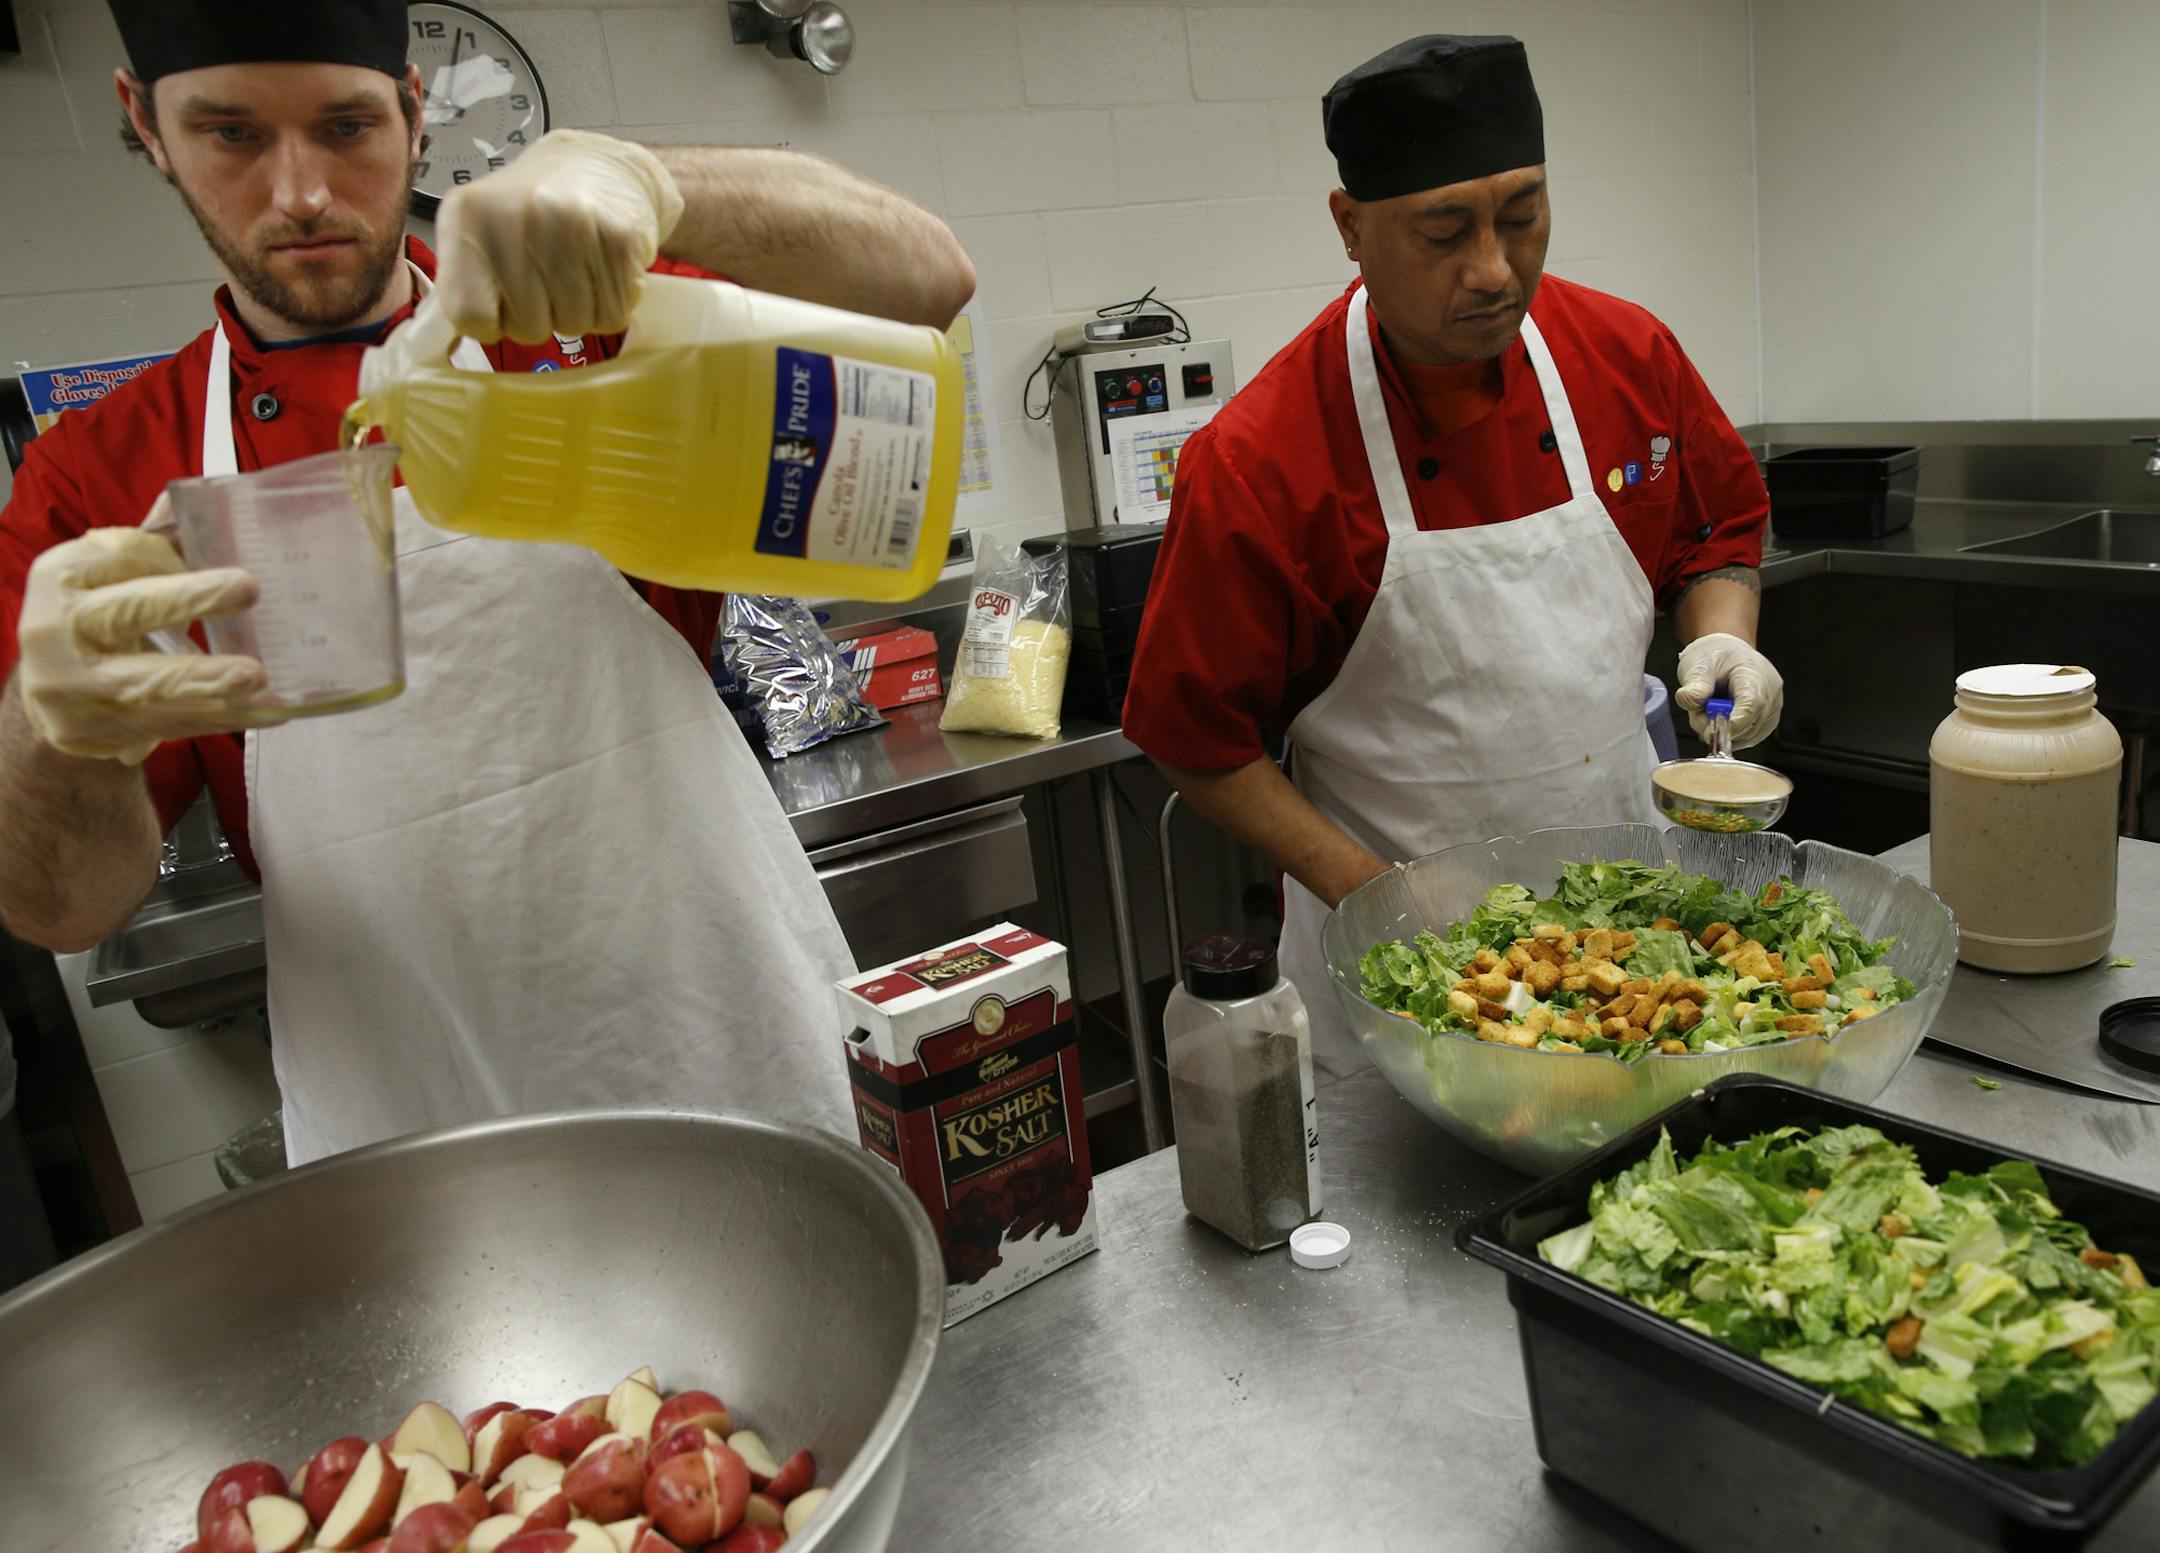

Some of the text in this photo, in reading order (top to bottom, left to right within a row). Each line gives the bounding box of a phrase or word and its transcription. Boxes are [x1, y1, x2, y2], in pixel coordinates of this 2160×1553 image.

[412, 21, 446, 38] 12
[464, 32, 476, 49] 1
[510, 94, 530, 111] 3
[507, 130, 527, 146] 4
[415, 161, 431, 178] 7
[453, 170, 472, 185] 6
[50, 373, 81, 388] Use
[50, 386, 106, 404] Gloves
[788, 363, 811, 432] PRIDE
[911, 667, 936, 682] 627
[943, 1083, 1059, 1161] KOSHER
[996, 1109, 1053, 1157] SALT
